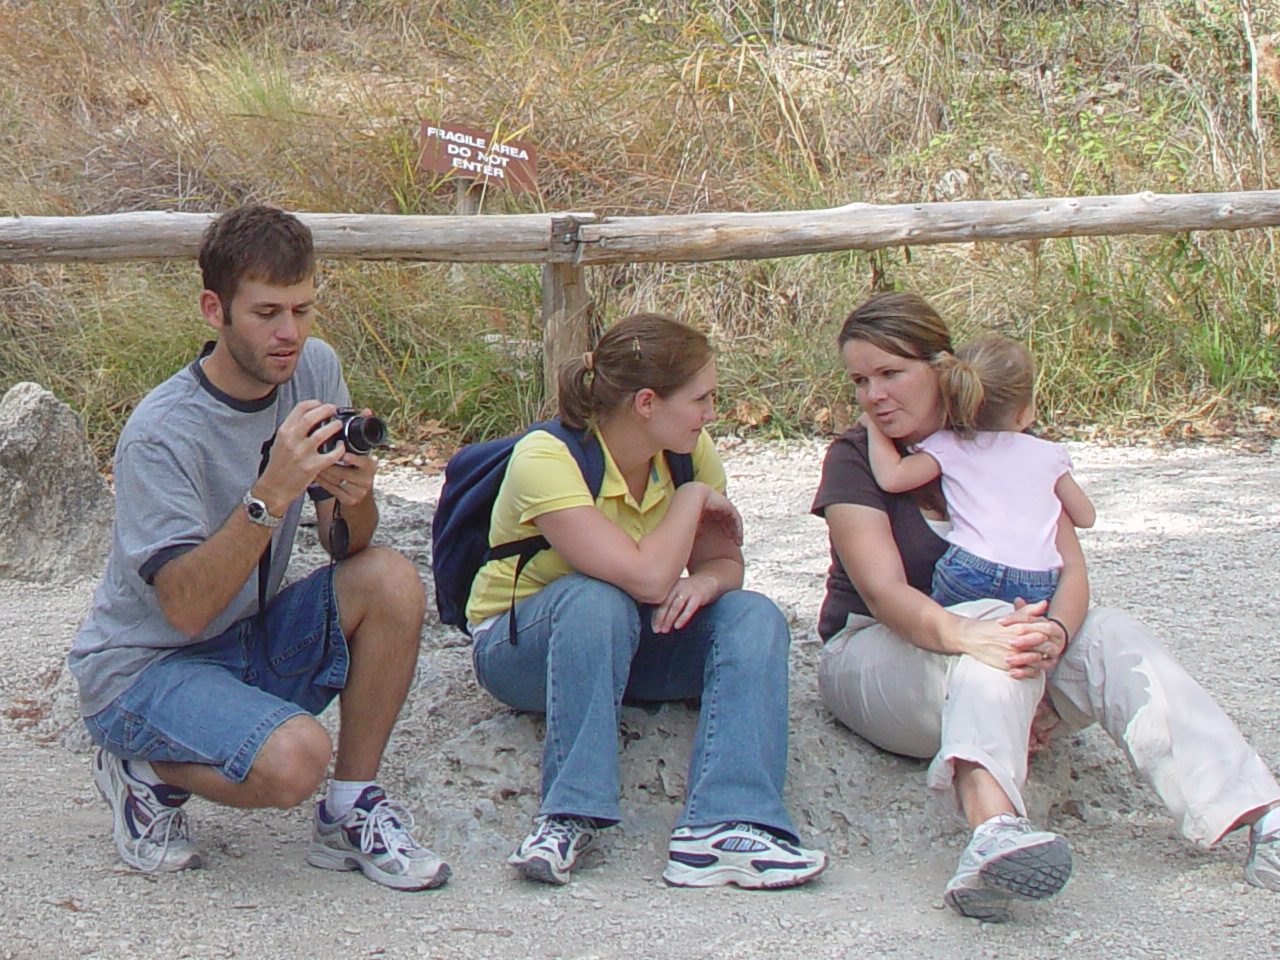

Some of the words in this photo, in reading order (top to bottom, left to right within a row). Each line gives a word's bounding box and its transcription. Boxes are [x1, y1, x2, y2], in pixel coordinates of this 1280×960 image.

[427, 126, 486, 149] FRAGILE
[491, 143, 529, 161] AREA
[447, 144, 472, 158] DO
[477, 151, 510, 167] NOT
[451, 157, 505, 179] ENTER
